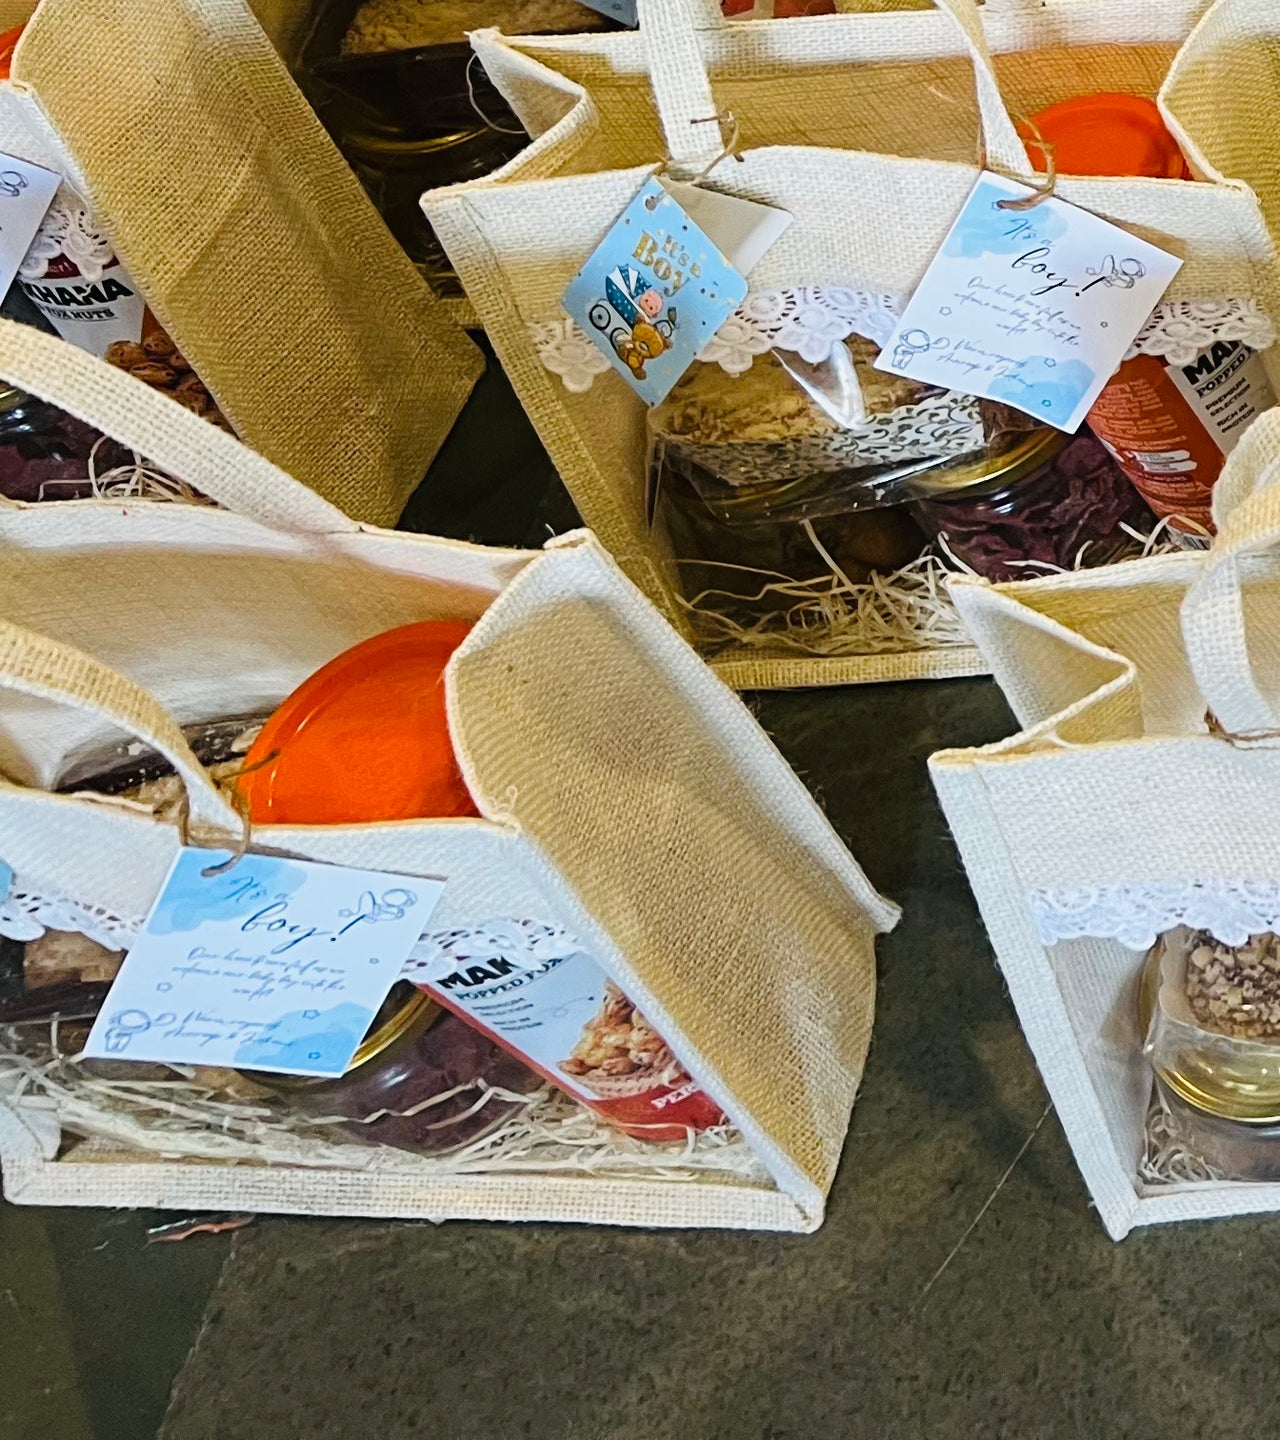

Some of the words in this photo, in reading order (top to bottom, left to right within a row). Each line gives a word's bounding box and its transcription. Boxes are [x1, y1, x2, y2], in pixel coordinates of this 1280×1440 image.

[631, 233, 691, 299] Boy
[1011, 247, 1104, 298] boy!
[242, 900, 369, 953] boy!
